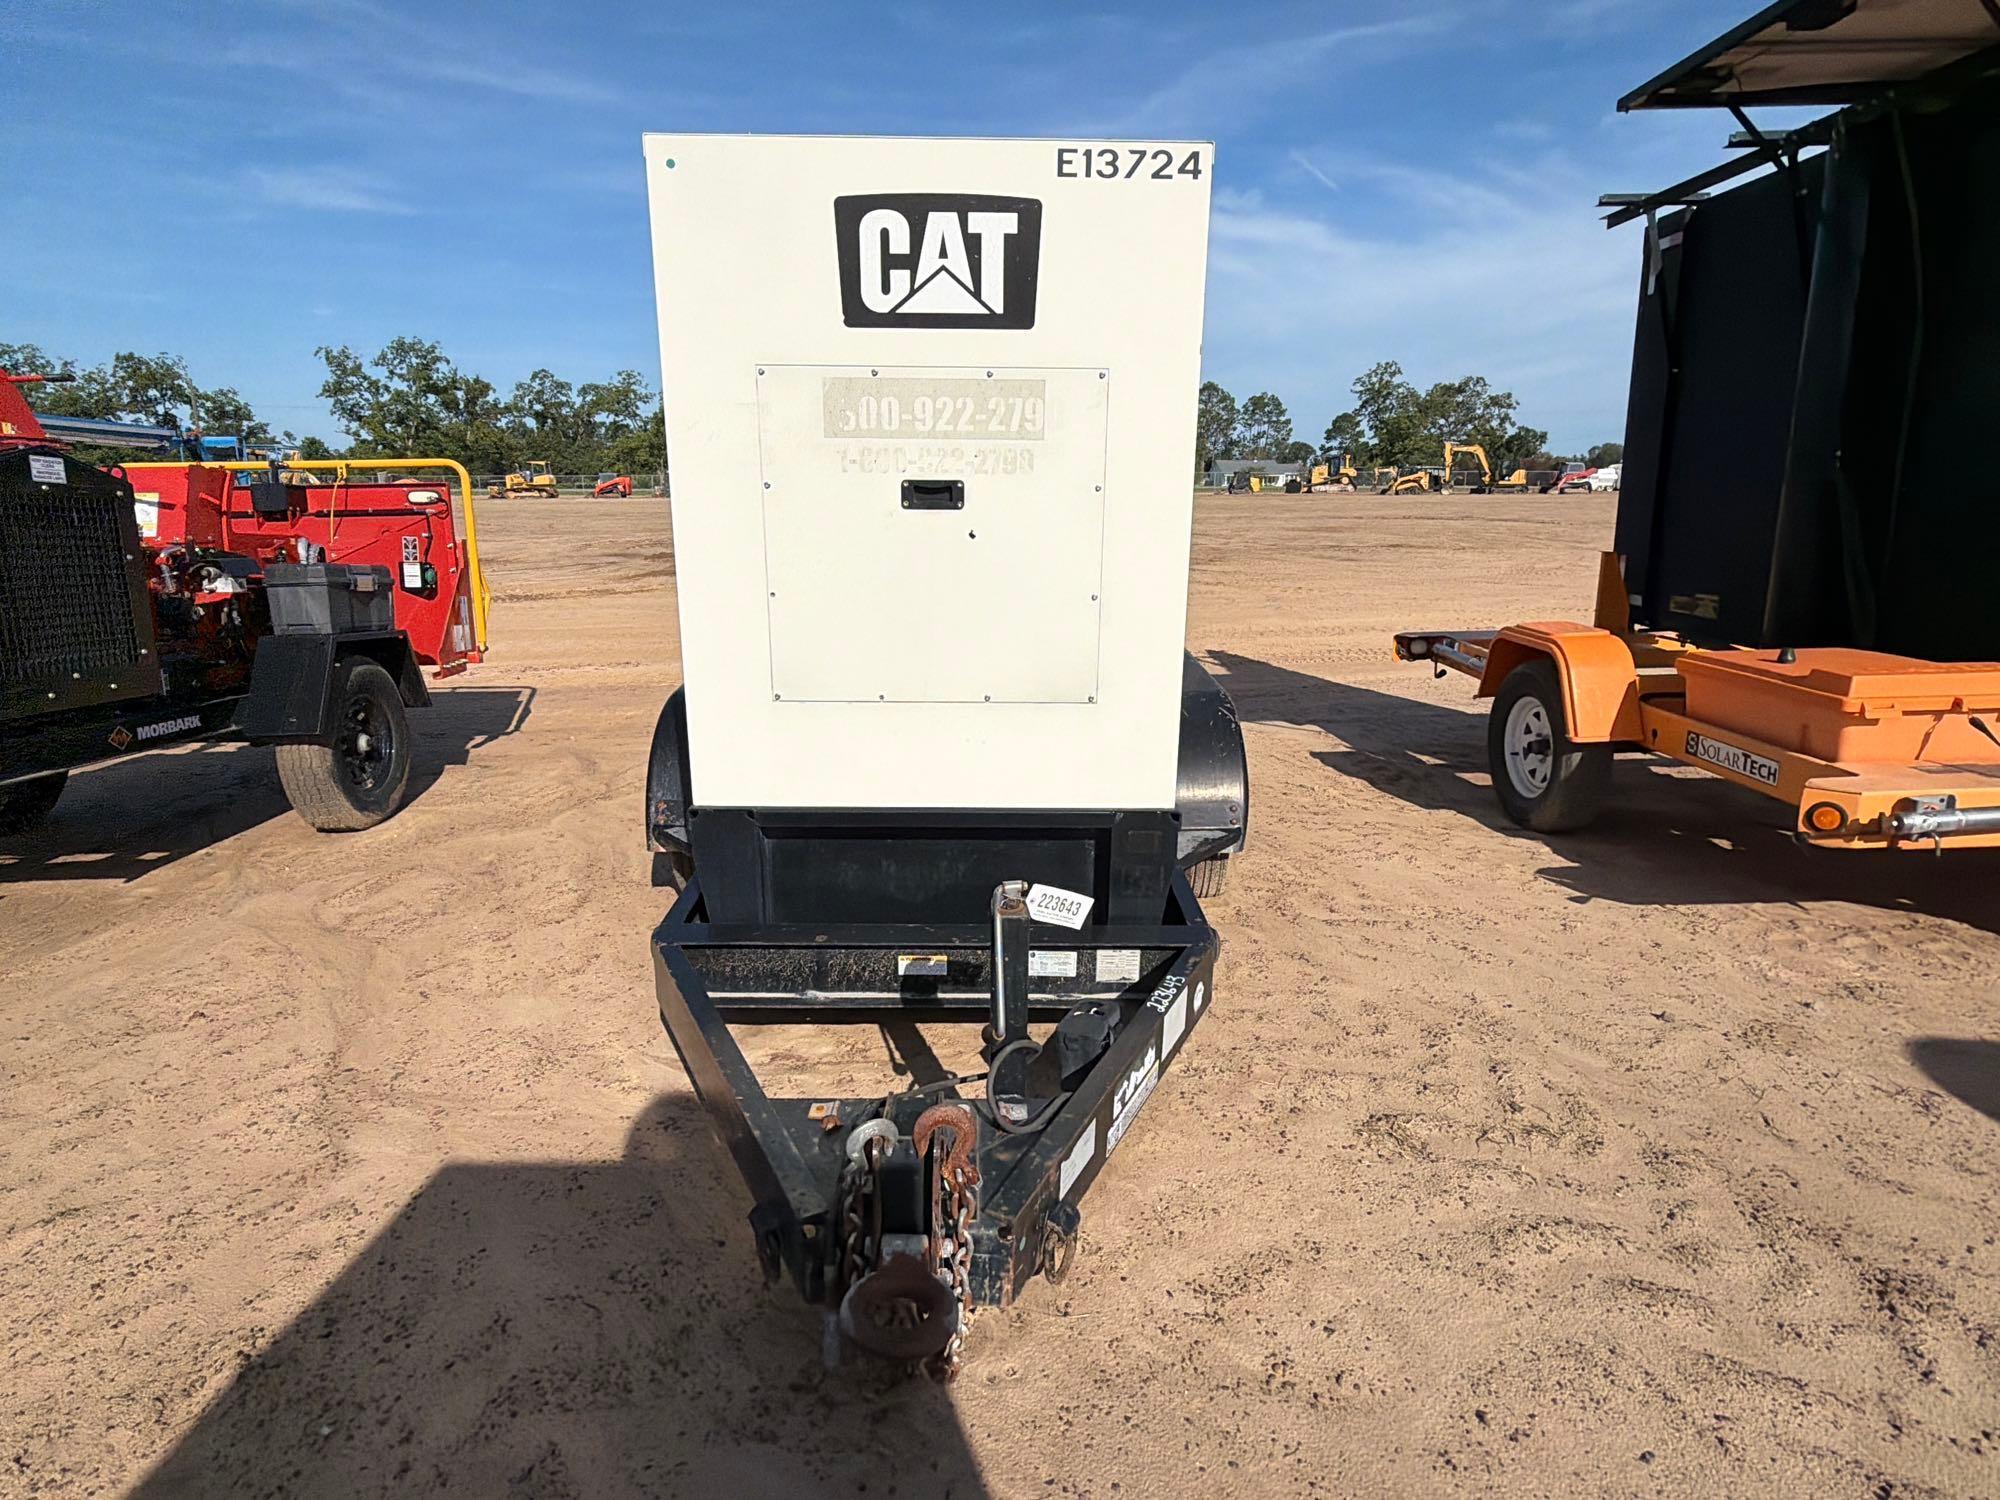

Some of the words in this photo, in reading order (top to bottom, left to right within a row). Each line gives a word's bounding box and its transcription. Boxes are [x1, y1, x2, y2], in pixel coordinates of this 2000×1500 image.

[1057, 148, 1202, 180] E13724
[858, 208, 1019, 314] CAT
[136, 715, 202, 740] MORBARK
[1037, 893, 1082, 916] 223643
[1146, 975, 1185, 1013] 223643
